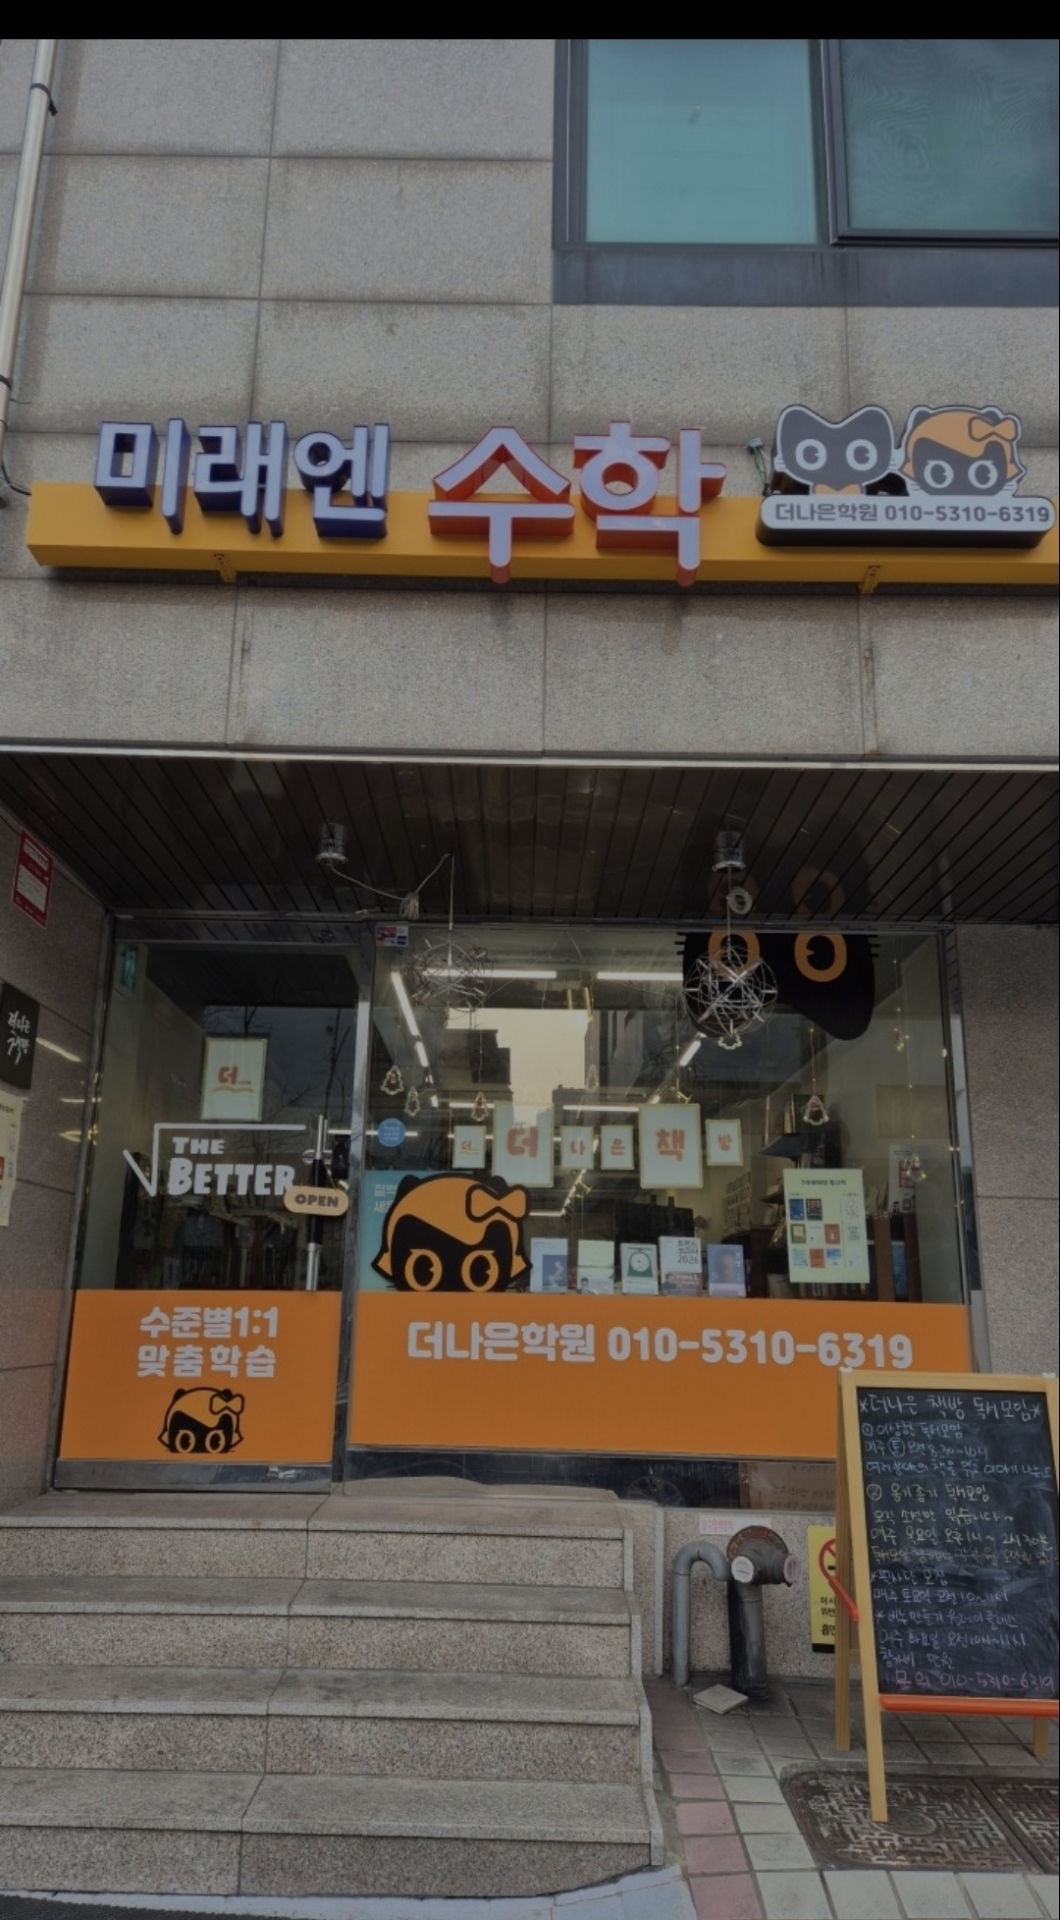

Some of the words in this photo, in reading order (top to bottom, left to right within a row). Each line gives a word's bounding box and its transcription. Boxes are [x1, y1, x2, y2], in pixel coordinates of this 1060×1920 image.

[95, 418, 390, 536] 미래엔
[428, 420, 727, 582] 수학
[775, 503, 878, 522] 더나은학원
[884, 504, 1050, 523] 010-5310-6319
[172, 1136, 226, 1155] THE
[507, 1126, 539, 1159] 더
[570, 1141, 587, 1156] 나
[610, 1138, 626, 1157] 은
[655, 1128, 686, 1161] 책
[717, 1134, 733, 1152] 방
[167, 1157, 297, 1197] BETTER
[294, 1193, 339, 1209] OPEN
[677, 1254, 700, 1265] 2026
[406, 1320, 596, 1363] 더나은학원
[606, 1325, 914, 1369] 010-5310-6319
